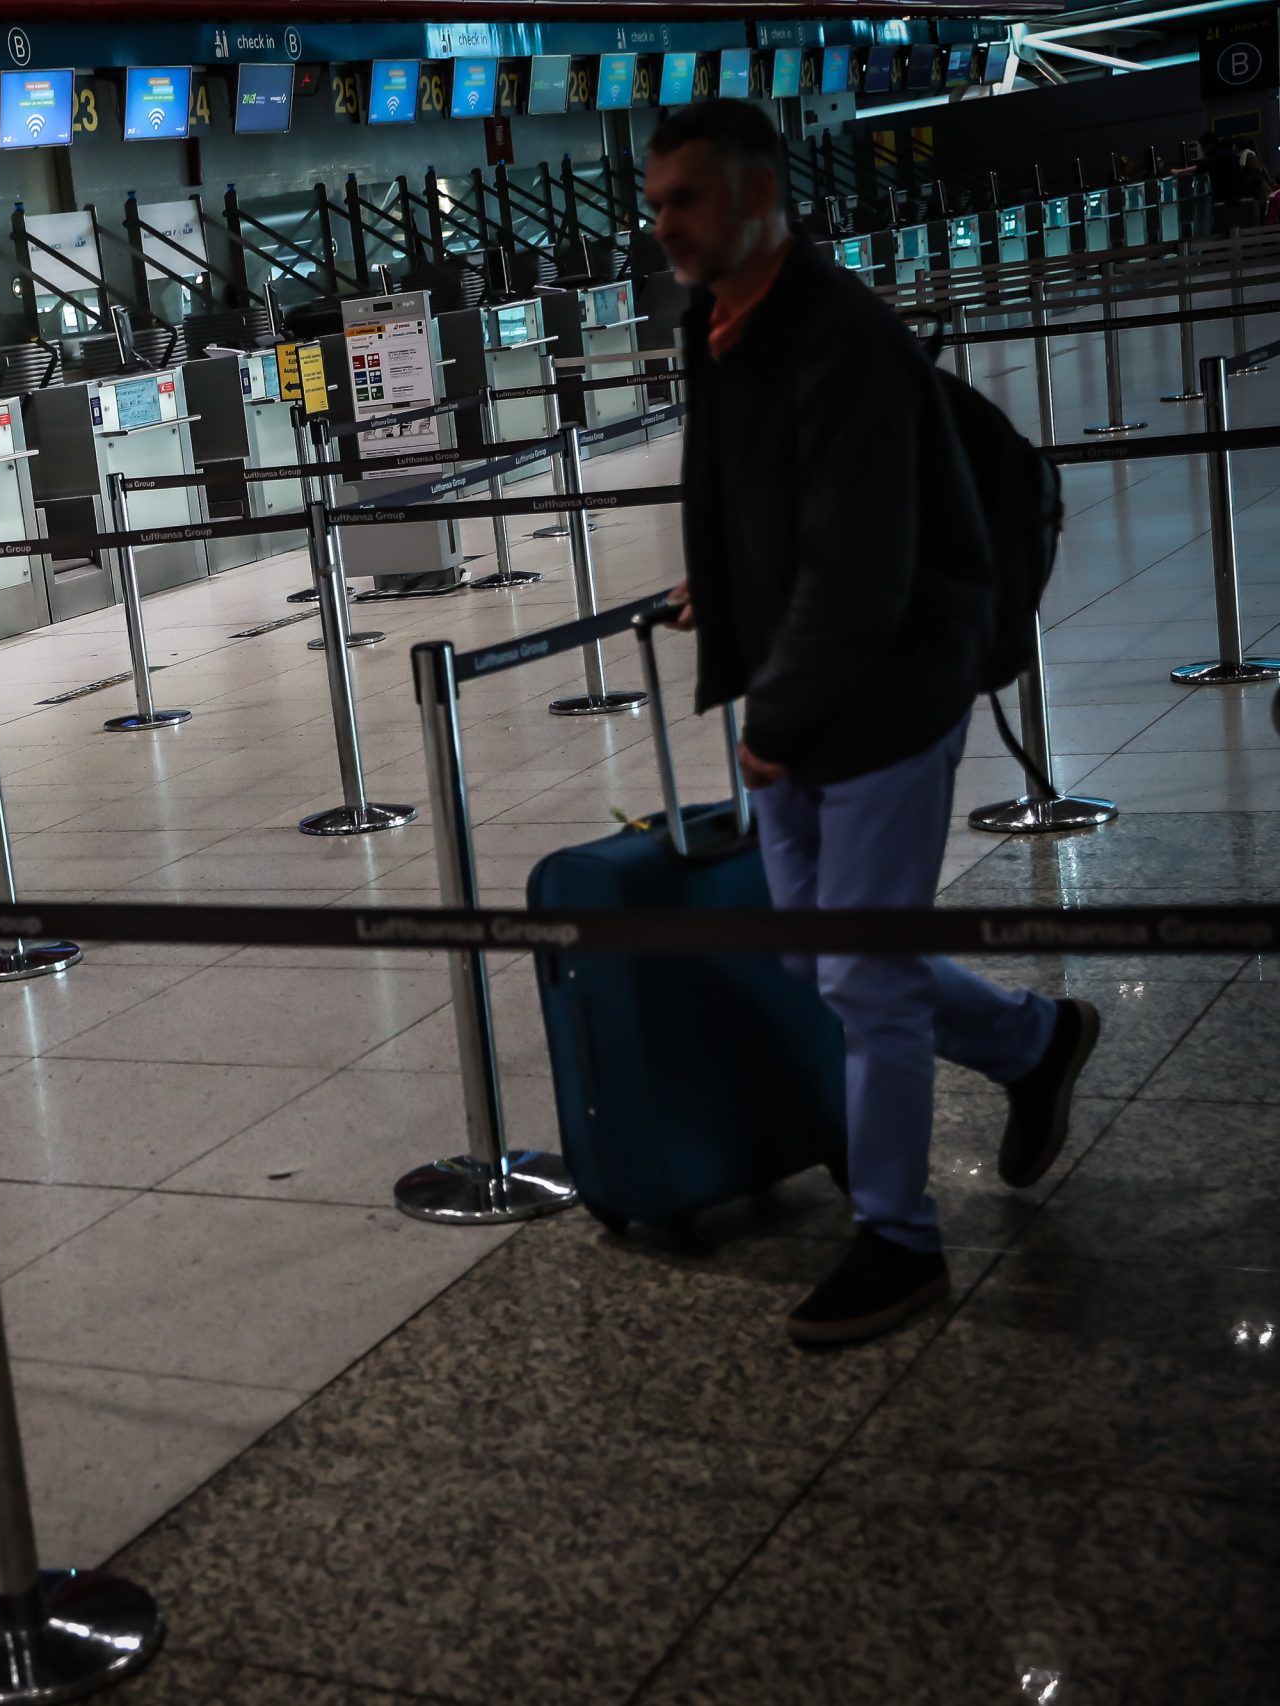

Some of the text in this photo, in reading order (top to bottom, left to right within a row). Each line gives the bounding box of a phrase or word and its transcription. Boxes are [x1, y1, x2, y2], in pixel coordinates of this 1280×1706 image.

[14, 35, 25, 58] B
[237, 34, 297, 53] check in B
[459, 33, 488, 46] check in
[1232, 53, 1248, 75] B
[332, 76, 358, 113] 25
[420, 75, 444, 112] 26
[499, 74, 519, 107] 27
[570, 70, 589, 102] 28
[397, 451, 460, 466] Lufthansa Group
[244, 468, 302, 480] Lufthansa Group
[134, 480, 155, 489] Group
[431, 477, 467, 494] Lufthansa Group
[533, 495, 618, 511] Lufthansa Group
[329, 509, 405, 523] Lufthansa Group
[140, 528, 212, 543] Lufthansa Group
[5, 544, 32, 556] Group
[355, 917, 580, 947] Lufthansa Group
[980, 916, 1271, 947] Lufthansa Group
